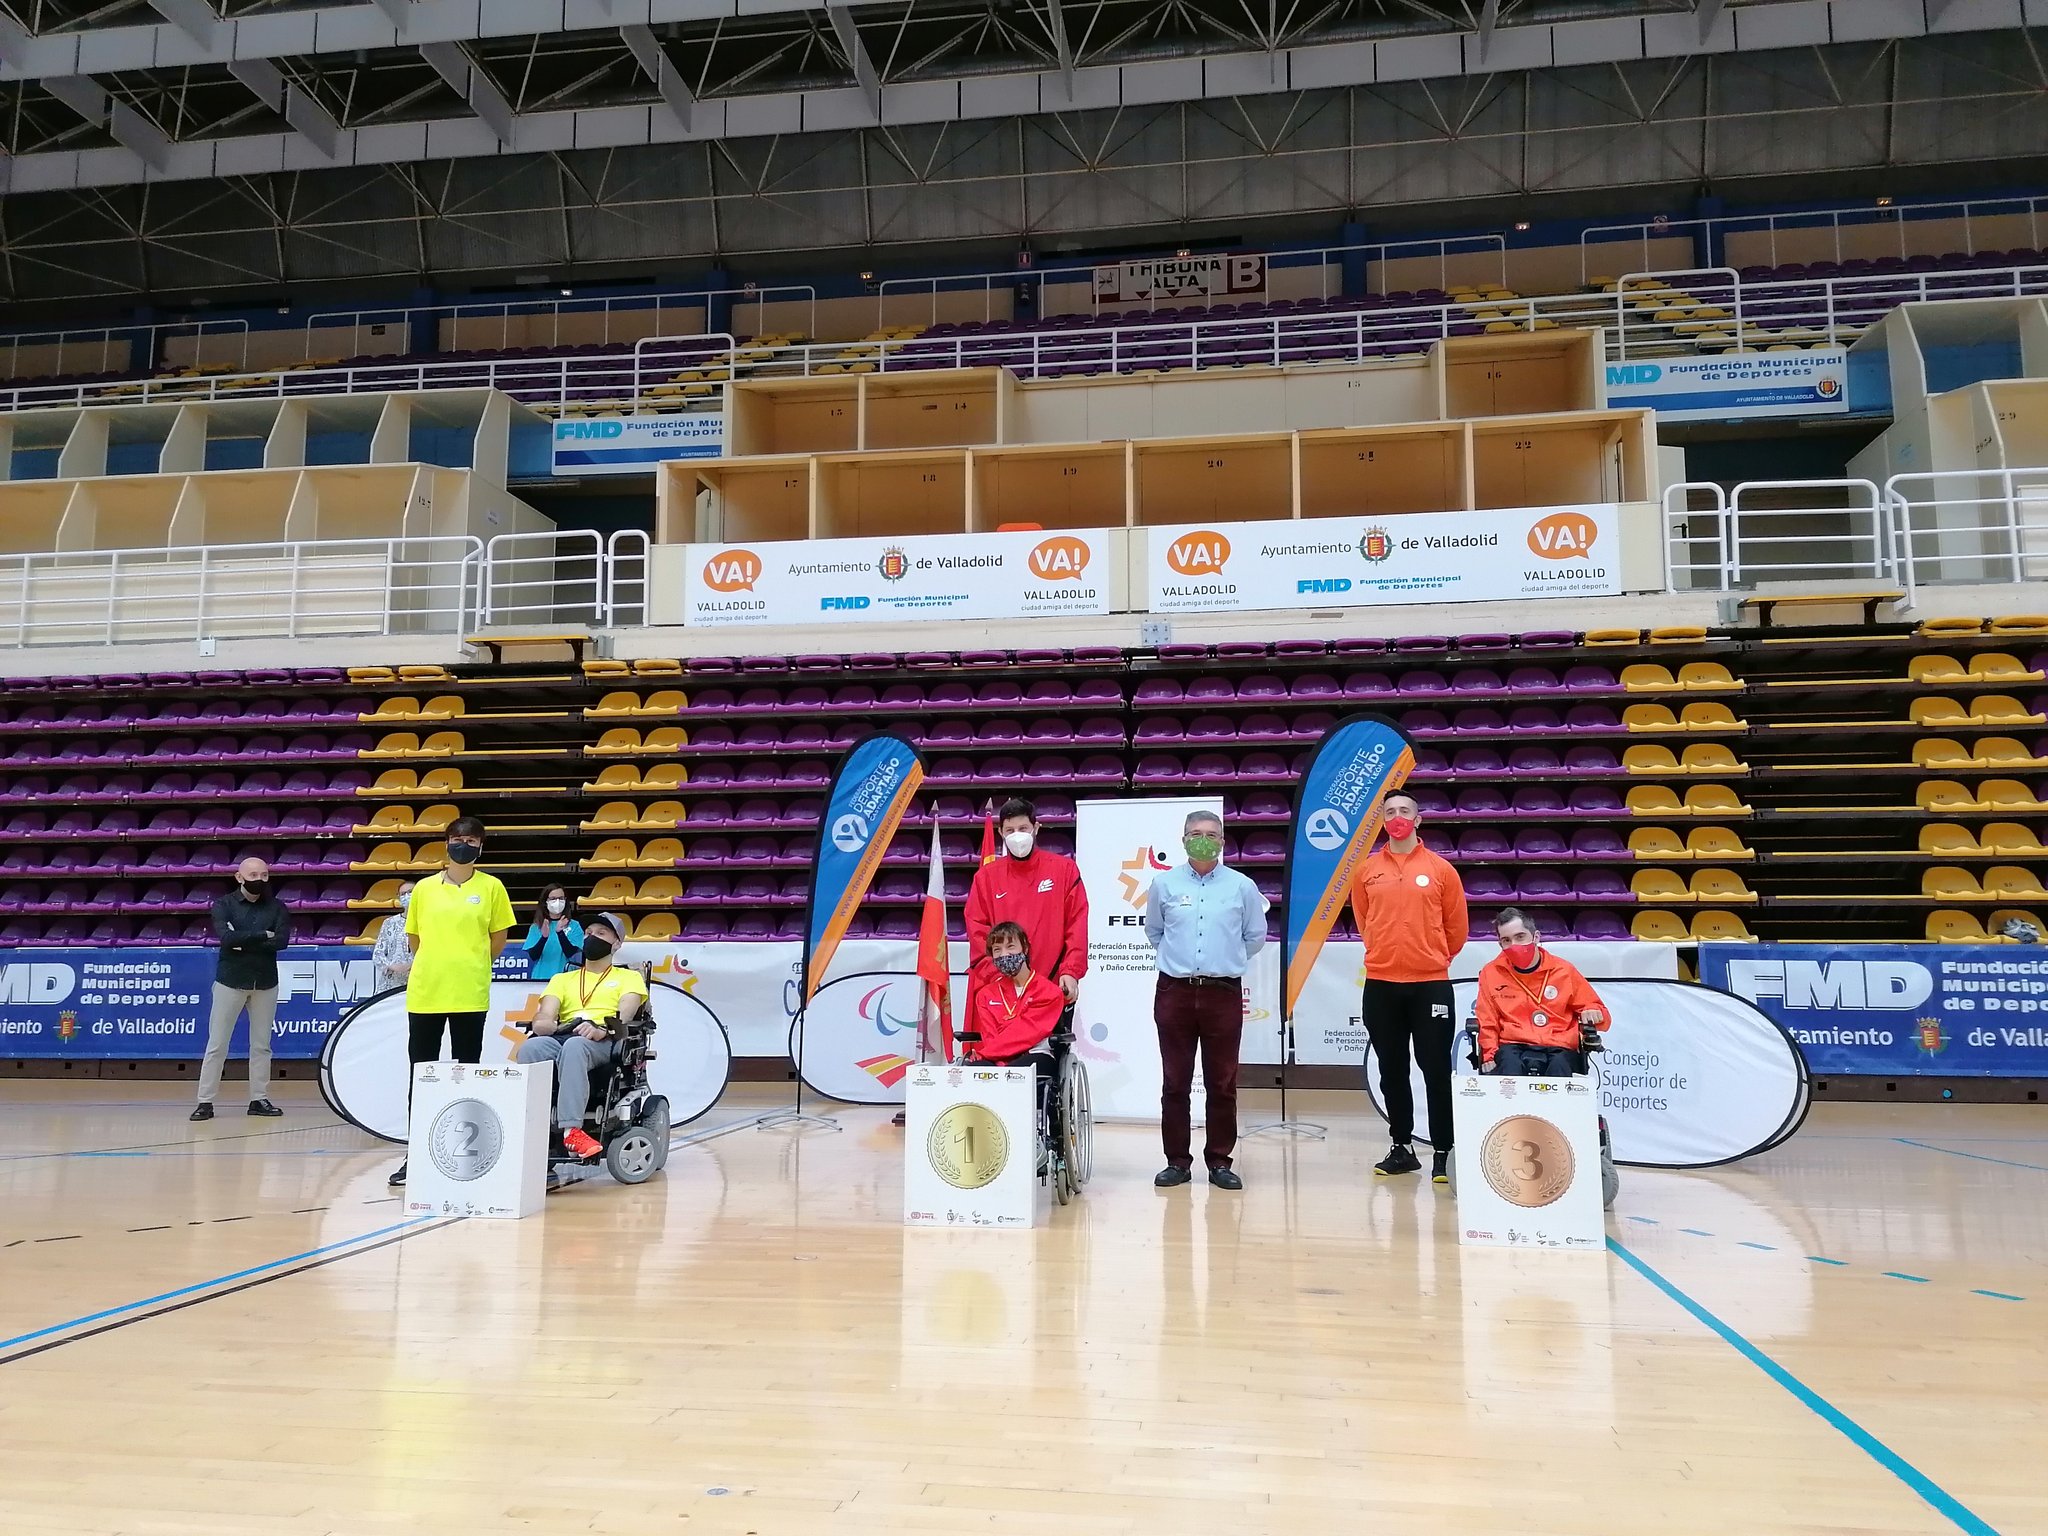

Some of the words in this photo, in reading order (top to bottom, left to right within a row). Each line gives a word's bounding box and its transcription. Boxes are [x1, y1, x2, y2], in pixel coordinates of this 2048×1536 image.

[1128, 255, 1222, 277] TRIBUNA
[1232, 256, 1261, 289] B
[1150, 275, 1200, 289] ALTA
[1669, 360, 1752, 373] Fundación
[1758, 356, 1842, 369] Municipal
[1701, 372, 1721, 381] de
[1727, 367, 1812, 380] Deportes
[556, 421, 623, 440] FMD
[627, 420, 694, 430] Fundación
[653, 430, 669, 438] de
[1534, 524, 1586, 550] VA!
[1261, 541, 1351, 558] Ayuntamiento
[1401, 537, 1419, 549] de
[1424, 533, 1498, 549] Valladolid
[1034, 547, 1080, 571] VA!
[1173, 541, 1221, 567] VA!
[709, 560, 753, 584] VA!
[789, 561, 871, 577] Ayuntamiento
[916, 557, 933, 569] de
[937, 555, 1003, 569] Valladolid
[1360, 577, 1408, 585] Fundación
[1524, 568, 1606, 581] VALLADOLID
[1162, 584, 1237, 596] VALLADOLID
[1297, 578, 1352, 594] FMD
[1546, 585, 1567, 593] amiga
[1582, 583, 1609, 592] deporte
[878, 595, 921, 603] Fundación
[1024, 589, 1096, 600] VALLADOLID
[697, 600, 765, 611] VALLADOLID
[821, 597, 871, 611] FMD
[1074, 602, 1098, 611] deporte
[1182, 600, 1201, 608] amiga
[1215, 599, 1240, 607] deporte
[745, 613, 768, 621] deporte
[1323, 766, 1348, 801] FEDERACIÓN
[1329, 747, 1369, 806] DEPORTE
[1340, 743, 1386, 814] ADAPTADO
[853, 761, 887, 814] DEPORTE
[863, 757, 900, 819] ADAPTADO
[1350, 784, 1371, 816] CASTILLA
[1371, 762, 1385, 781] LEÓN
[870, 796, 889, 822] CASTILLA
[888, 774, 900, 792] LEÓN
[1089, 942, 1127, 950] Federación
[1088, 953, 1097, 961] de
[1098, 953, 1130, 961] Personas
[83, 962, 171, 974] Fundación
[1100, 965, 1105, 973] y
[82, 978, 170, 990] Municipal
[1726, 959, 1934, 1011] FMD
[1942, 978, 2048, 995] Municip
[80, 993, 103, 1005] de
[108, 993, 200, 1006] Deportes
[1943, 997, 1976, 1011] de
[92, 1018, 114, 1034] de
[118, 1018, 196, 1034] Valladolid
[1324, 1029, 1367, 1037] Federación
[1967, 1027, 1997, 1047] de
[1337, 1045, 1343, 1053] y
[1344, 1044, 1365, 1052] Daño
[1603, 1048, 1659, 1070] Consejo
[1602, 1069, 1665, 1092] Superior
[1669, 1072, 1687, 1089] de
[1602, 1091, 1668, 1112] Deportes
[452, 1121, 479, 1157] 2
[953, 1126, 974, 1163] 1
[1511, 1140, 1544, 1181] 3
